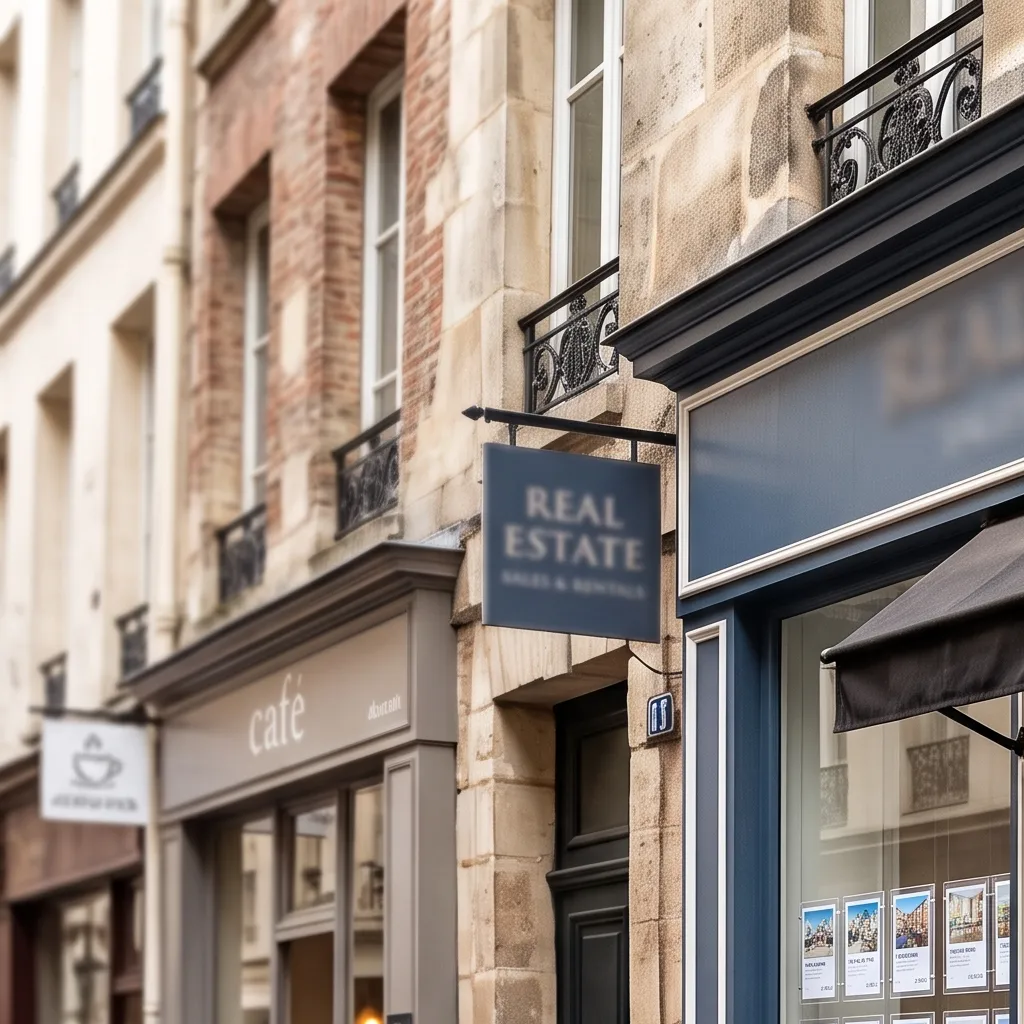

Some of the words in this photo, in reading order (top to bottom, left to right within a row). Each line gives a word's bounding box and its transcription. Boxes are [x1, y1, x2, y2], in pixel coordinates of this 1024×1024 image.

[525, 485, 624, 529] REAL
[504, 523, 645, 571] ESTATE
[249, 673, 305, 756] café
